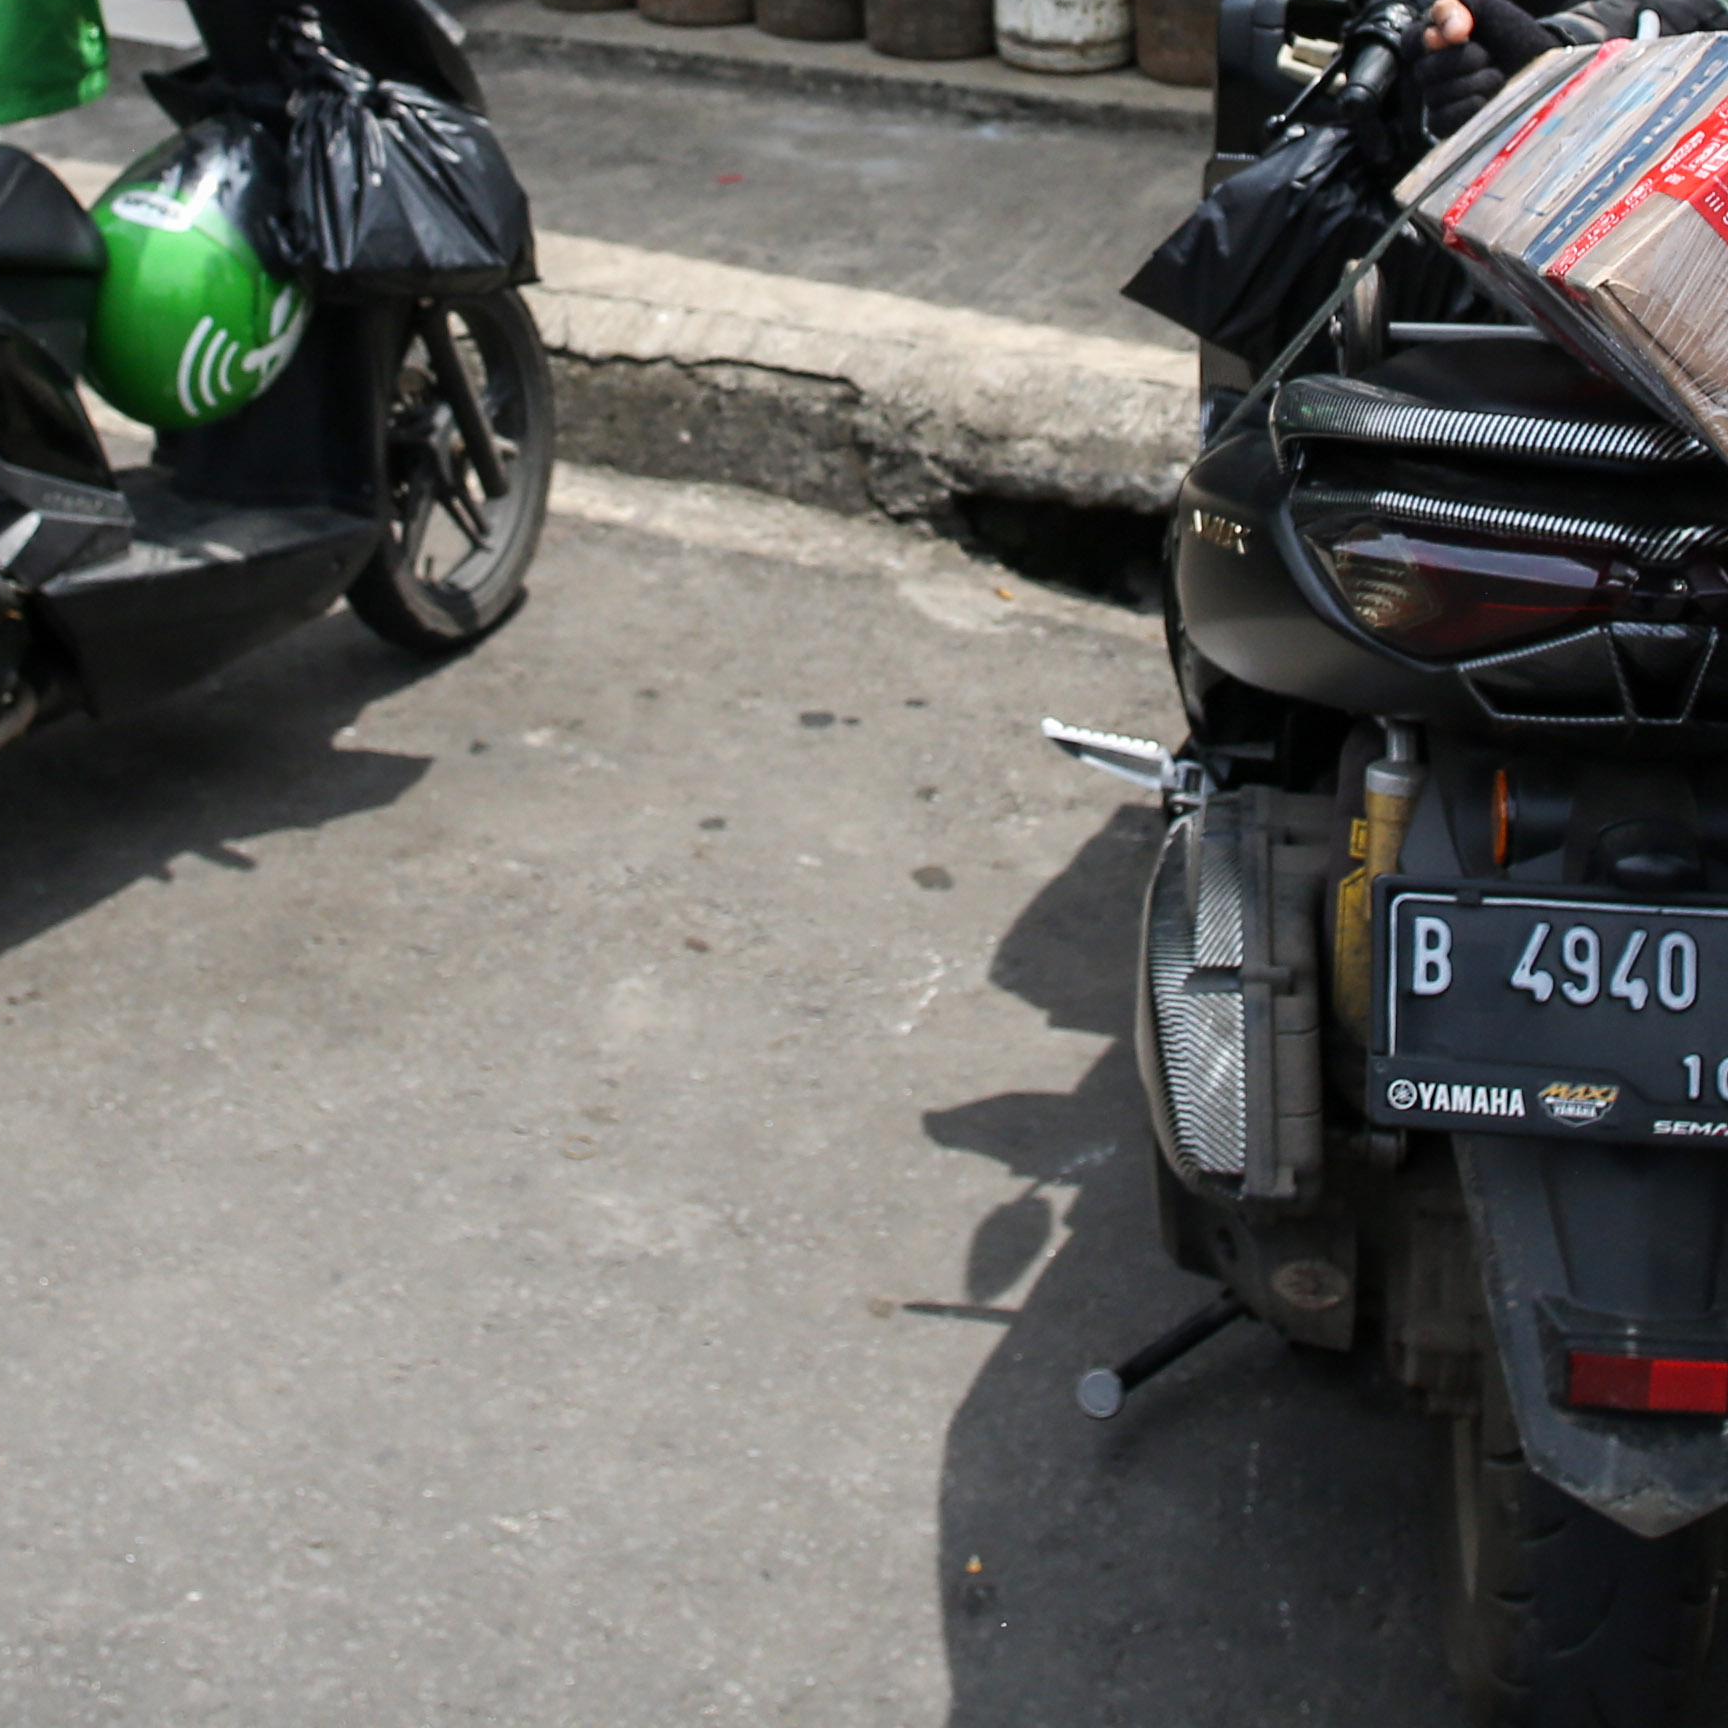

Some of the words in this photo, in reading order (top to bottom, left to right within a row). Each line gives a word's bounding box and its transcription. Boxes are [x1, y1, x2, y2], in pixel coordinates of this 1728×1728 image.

[1411, 914, 1454, 997] B
[1508, 921, 1699, 1012] 4940
[1417, 1080, 1526, 1120] YAMAHA
